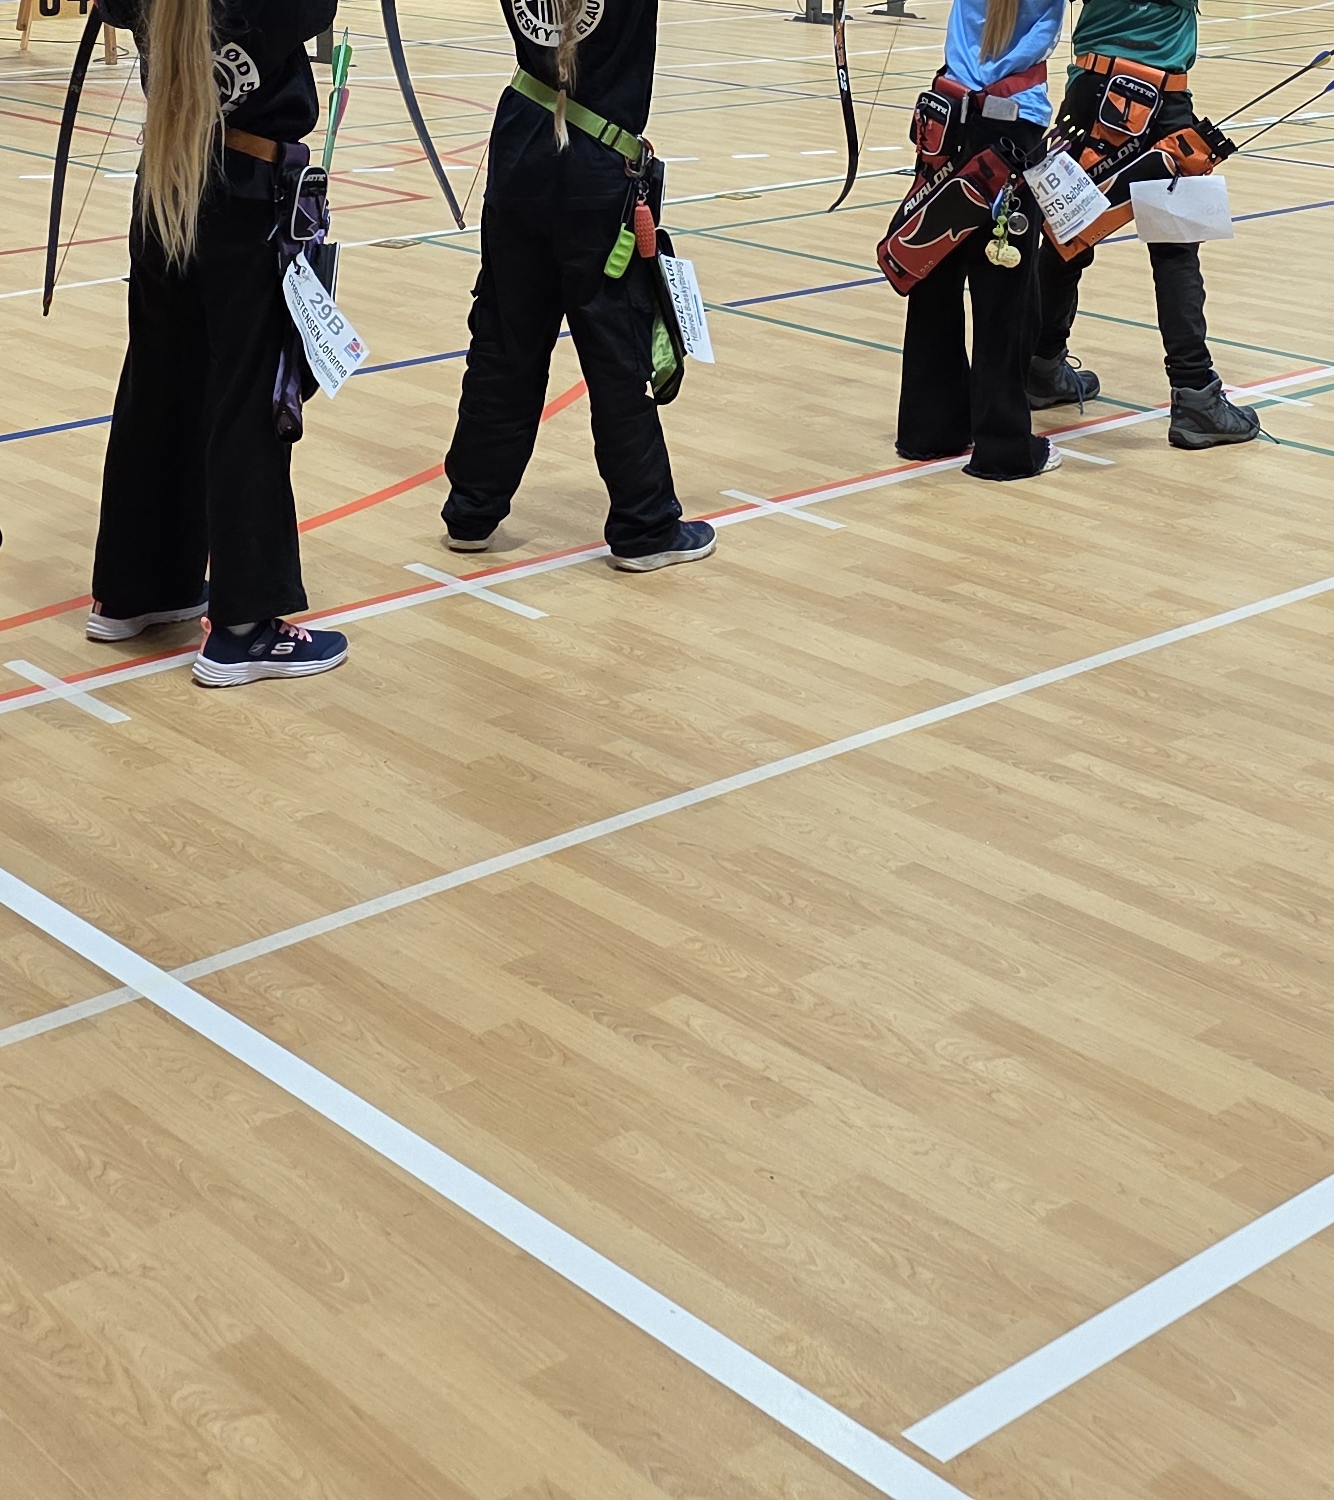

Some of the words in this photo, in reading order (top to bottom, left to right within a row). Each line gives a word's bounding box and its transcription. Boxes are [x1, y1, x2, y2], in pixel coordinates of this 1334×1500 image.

[1116, 77, 1156, 99] CLASSIC
[1088, 138, 1141, 180] VALON
[903, 161, 955, 217] AVALON
[1061, 175, 1090, 205] Isabella
[308, 291, 346, 337] 29B
[318, 339, 349, 378] Johanne
